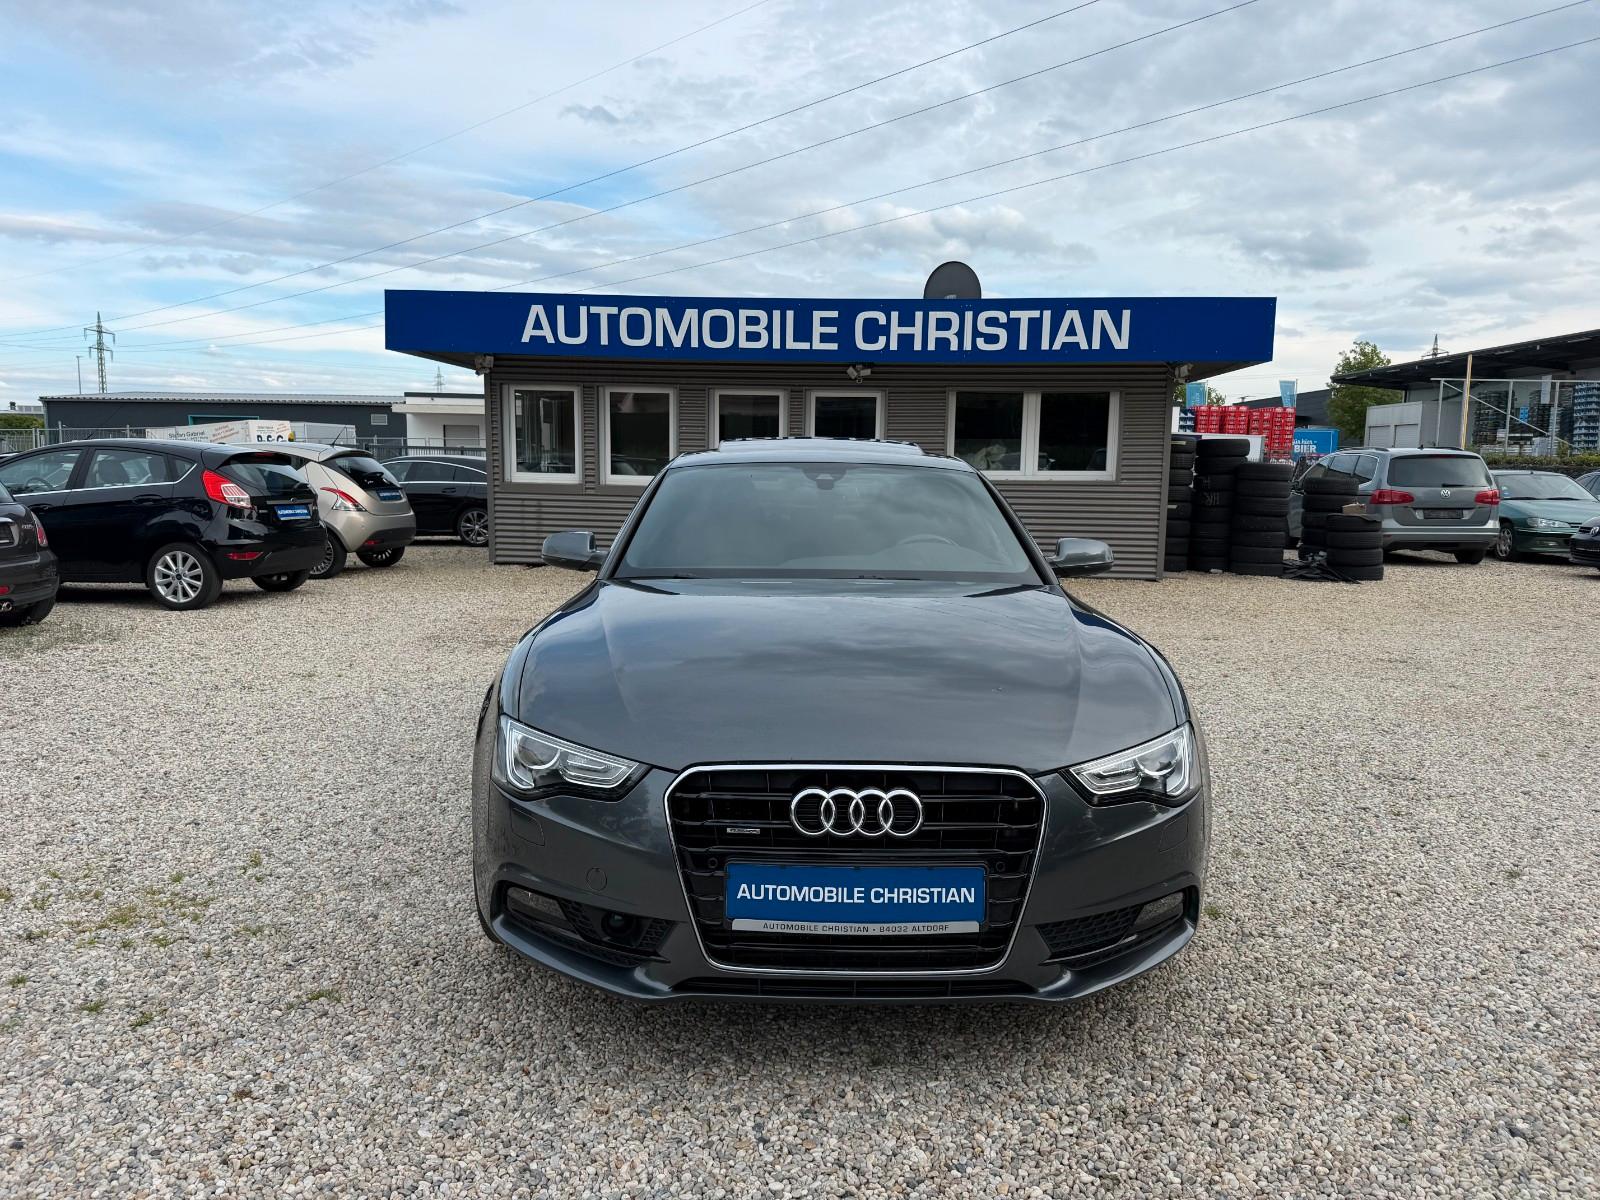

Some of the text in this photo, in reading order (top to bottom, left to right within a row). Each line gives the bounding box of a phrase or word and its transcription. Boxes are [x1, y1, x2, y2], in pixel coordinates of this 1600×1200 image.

[521, 304, 1131, 351] AUTOMOBILE CHRISTIAN
[737, 884, 975, 904] AUTOMOBILE CHRISTIAN
[763, 923, 950, 933] AUTOMOBILE CHRISTIAN 84032 ALTDORF
